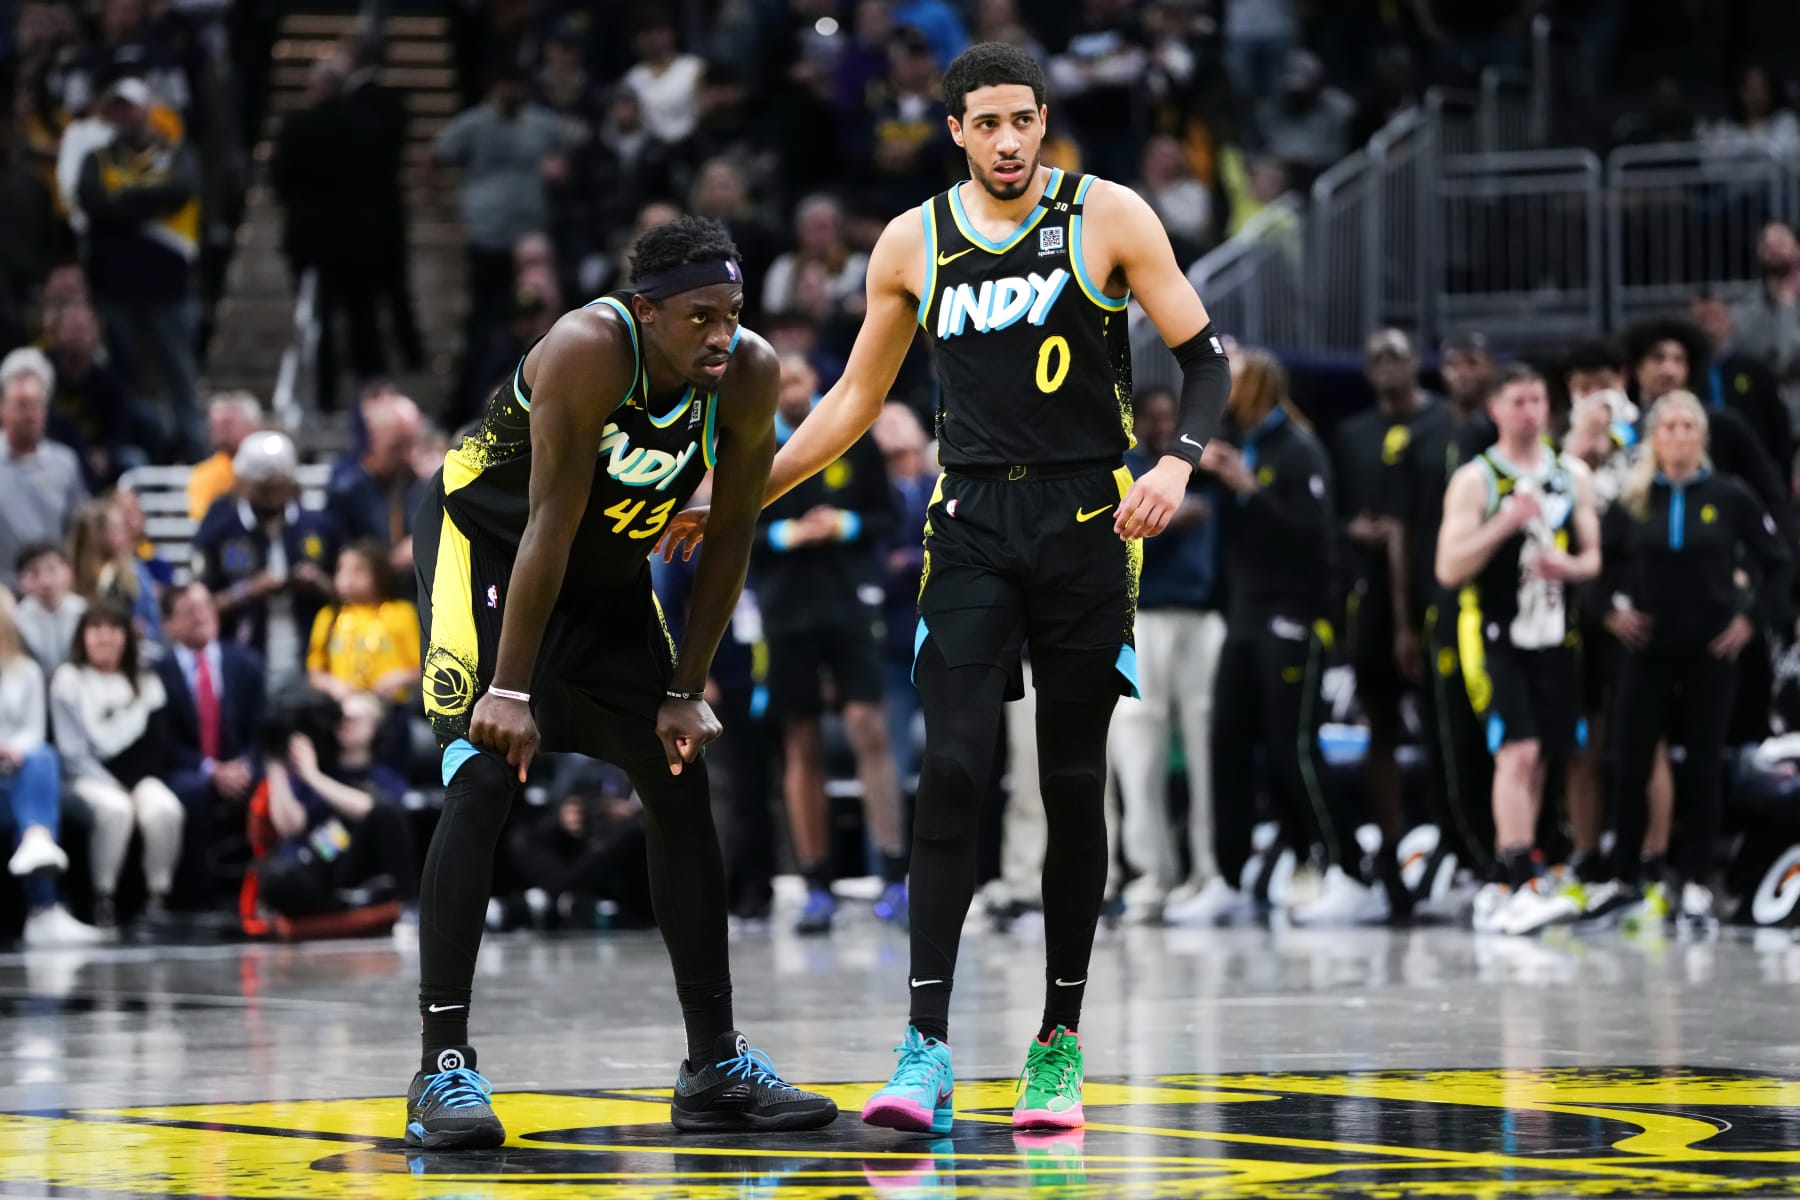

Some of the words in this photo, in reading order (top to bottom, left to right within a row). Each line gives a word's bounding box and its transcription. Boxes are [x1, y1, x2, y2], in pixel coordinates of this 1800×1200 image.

[1053, 201, 1069, 212] 30
[937, 268, 1070, 339] INDY
[1036, 335, 1071, 393] 0
[603, 498, 677, 539] 43
